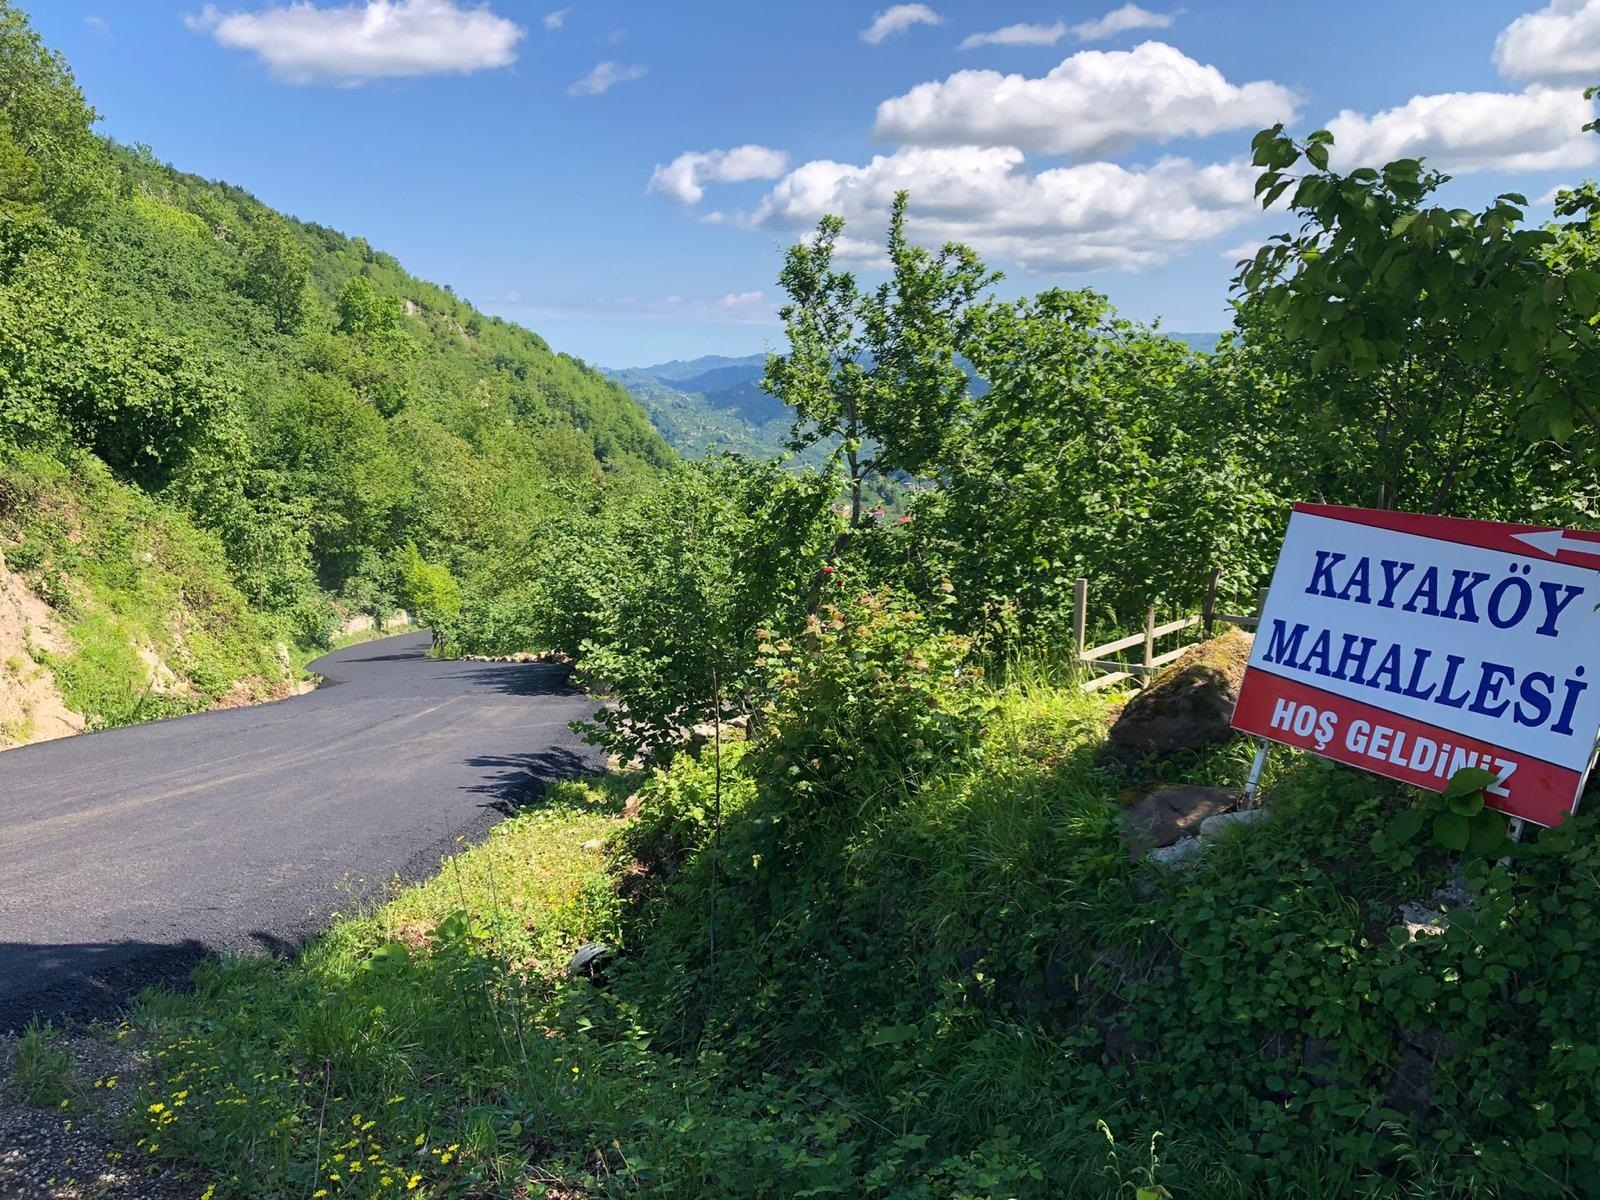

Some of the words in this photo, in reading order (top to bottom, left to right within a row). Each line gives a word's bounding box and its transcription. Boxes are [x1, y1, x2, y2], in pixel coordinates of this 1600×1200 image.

[1305, 551, 1584, 637] KAYAKÖY
[1262, 619, 1588, 736] MAHALLESİ
[1270, 698, 1338, 750] HOŞ
